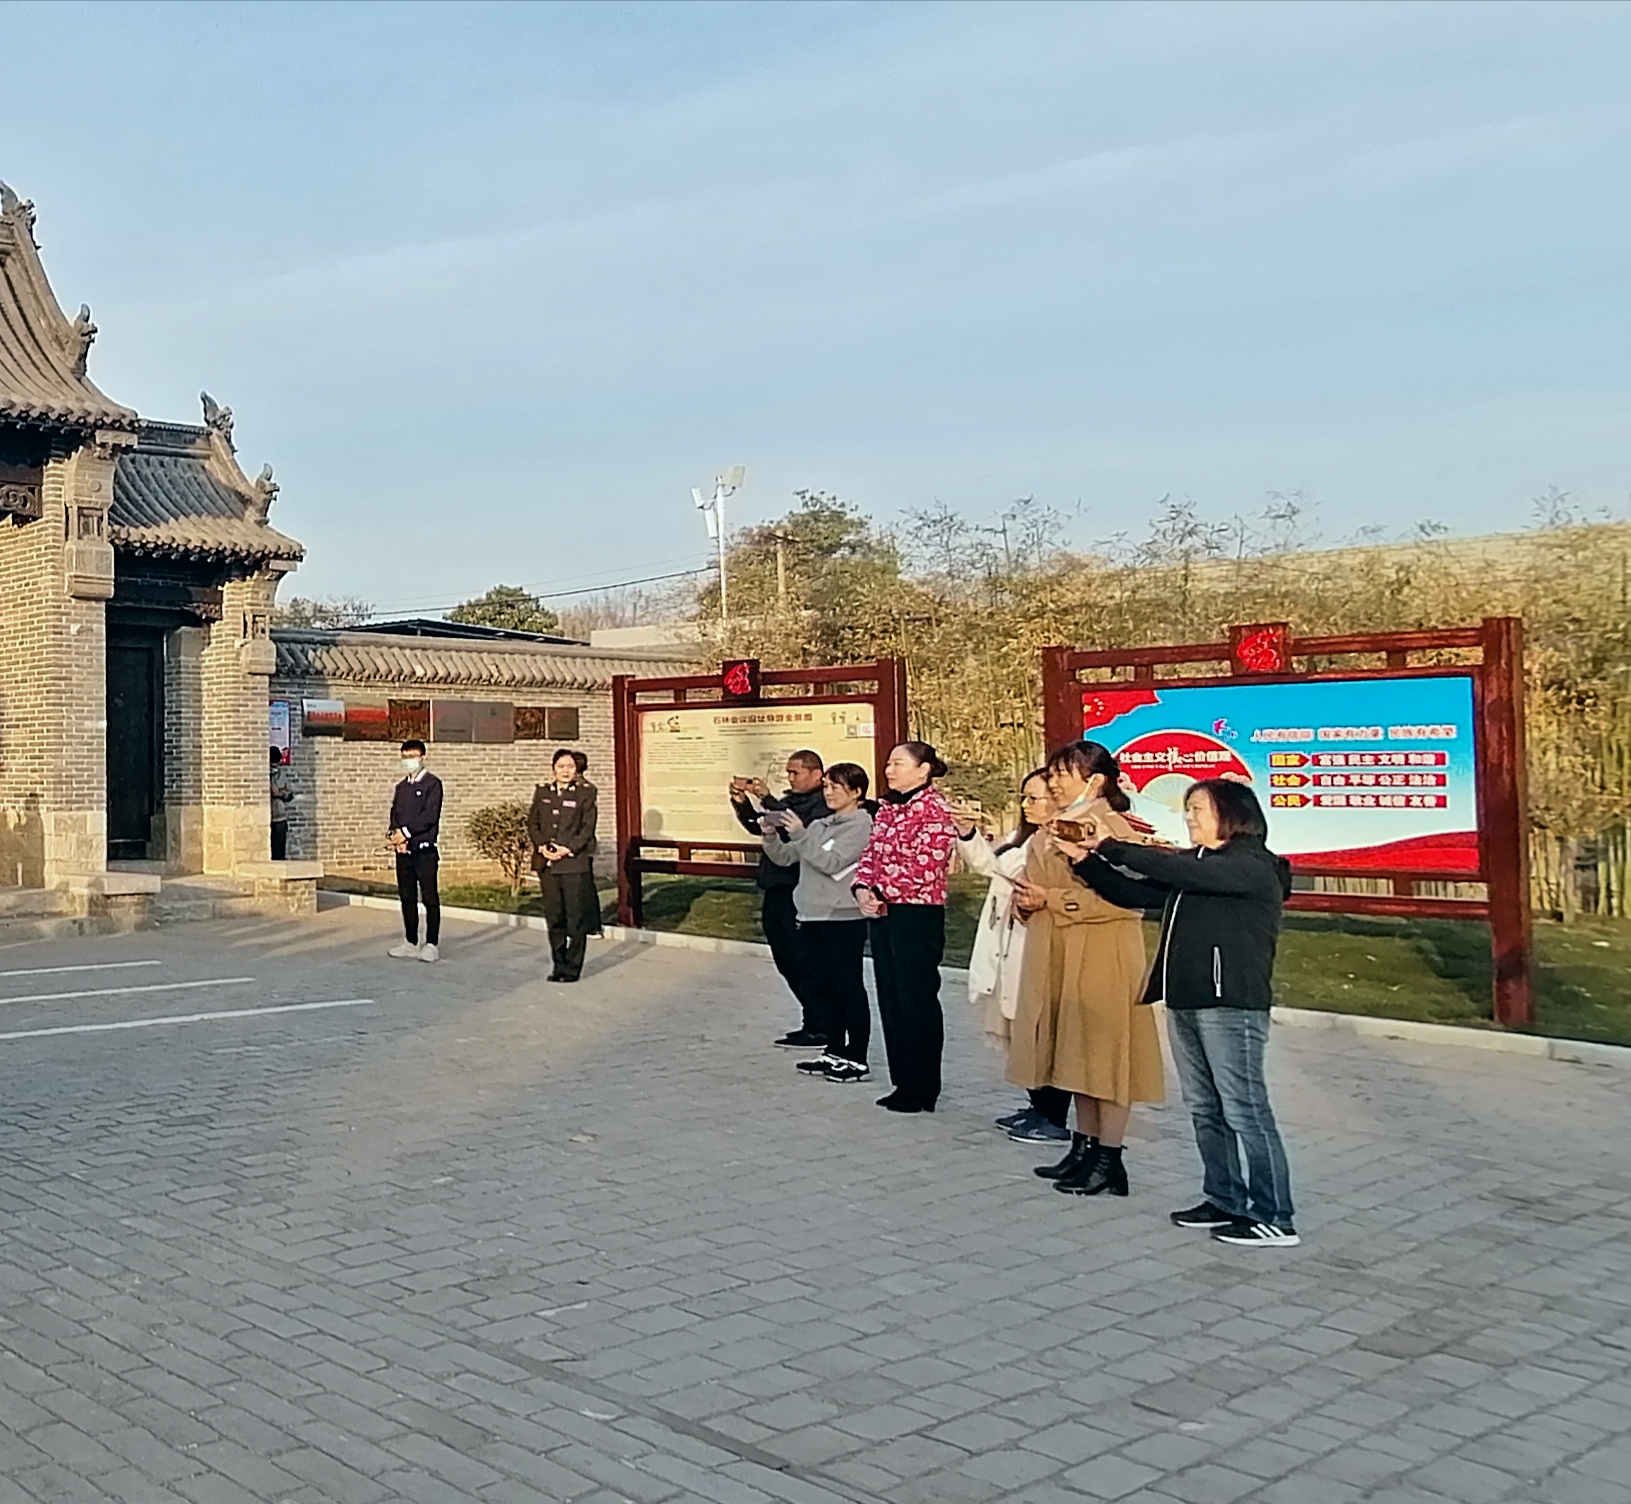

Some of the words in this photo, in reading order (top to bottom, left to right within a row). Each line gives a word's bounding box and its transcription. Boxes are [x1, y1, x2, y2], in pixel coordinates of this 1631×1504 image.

[1119, 747, 1231, 771] 社会主义核心价值观
[1271, 754, 1301, 766] 国家
[1348, 754, 1375, 766] 民主
[1377, 754, 1405, 766] 文明
[1272, 775, 1301, 787] 社会
[1349, 775, 1375, 787] 平等
[1378, 775, 1406, 787] 公正
[1273, 795, 1301, 807] 公民
[1349, 795, 1376, 807] 敬业
[1379, 795, 1405, 807] 诚信
